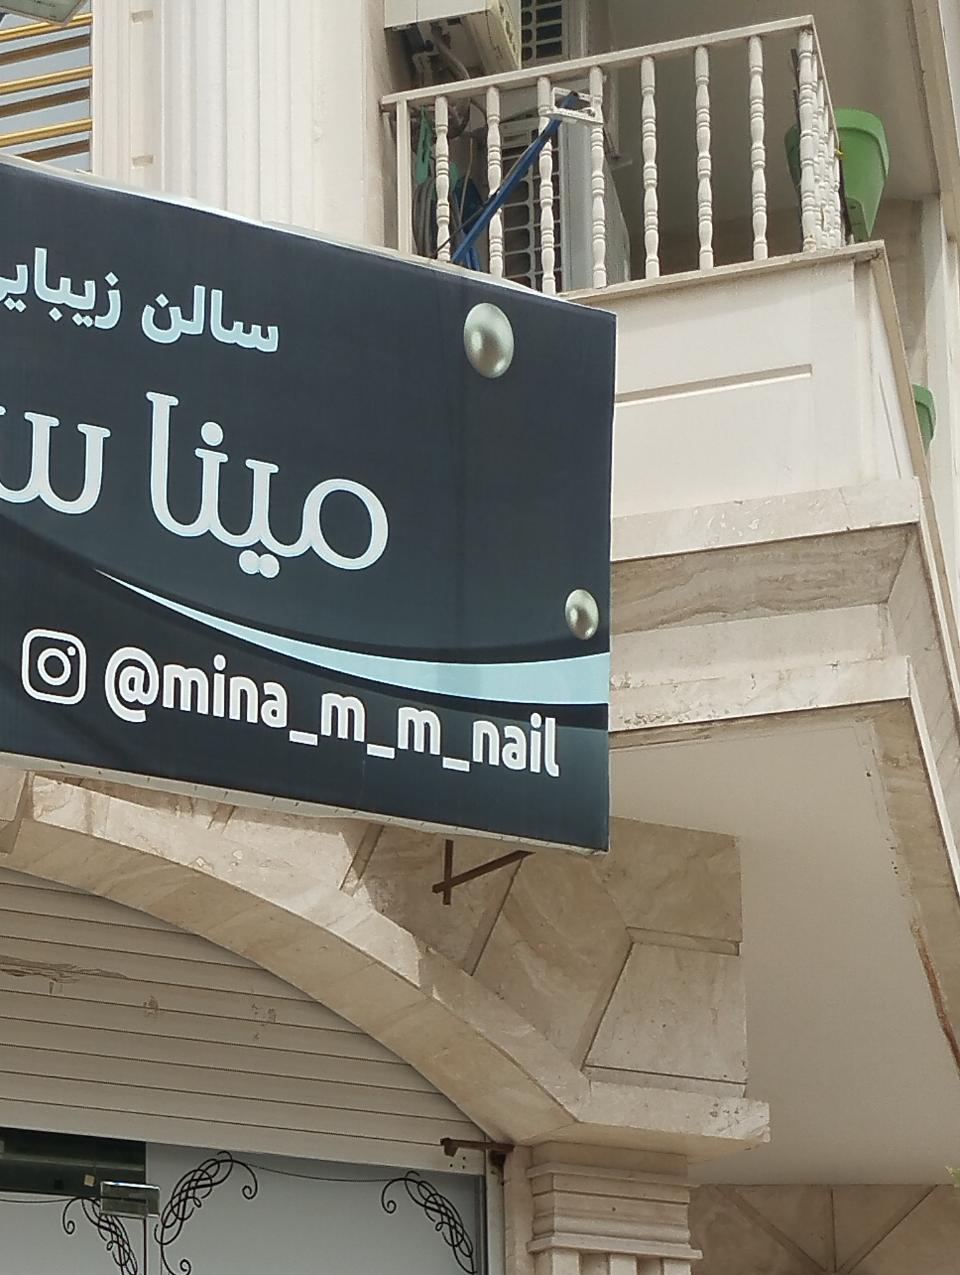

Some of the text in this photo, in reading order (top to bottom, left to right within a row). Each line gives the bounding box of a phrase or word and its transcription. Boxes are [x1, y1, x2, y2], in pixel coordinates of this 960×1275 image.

[141, 284, 279, 353] سالن
[146, 391, 389, 579] مینا
[104, 646, 561, 777] @mina_m_m_nail
